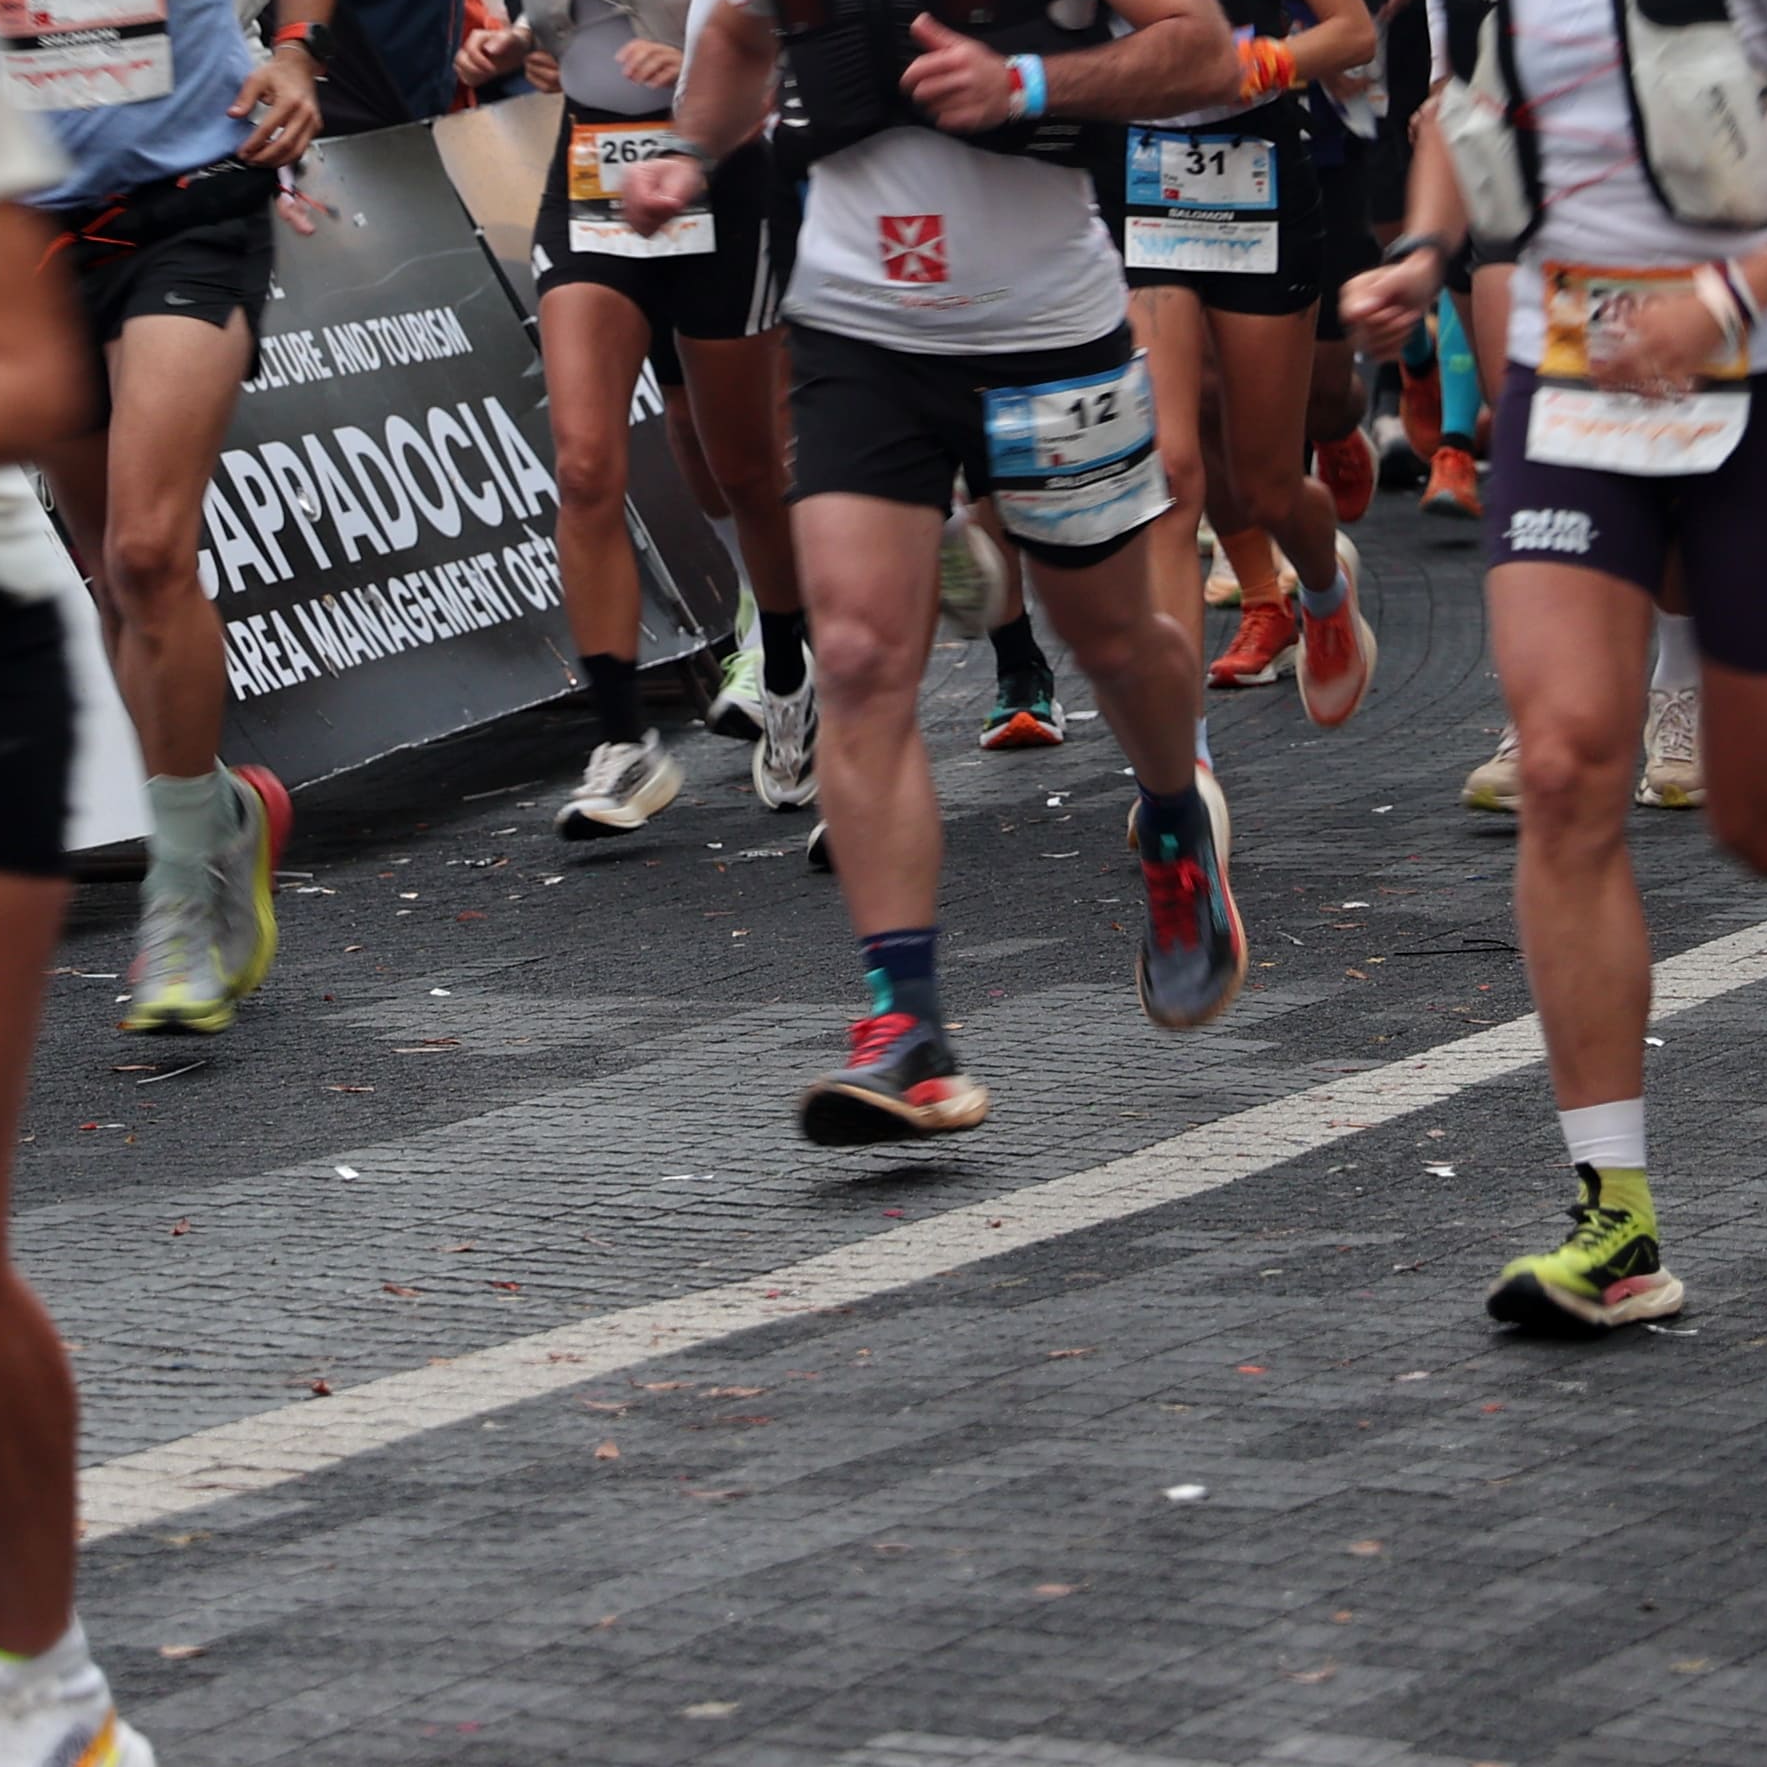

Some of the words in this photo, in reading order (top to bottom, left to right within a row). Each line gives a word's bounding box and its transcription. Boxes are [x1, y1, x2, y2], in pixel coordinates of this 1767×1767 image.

[1185, 150, 1226, 176] 31
[1167, 207, 1236, 222] SALOMON
[239, 330, 334, 394] ULTURE
[322, 318, 382, 377] AND
[365, 306, 474, 367] TOURISM
[1065, 390, 1121, 431] 12
[195, 396, 561, 603] APPADOCIA
[223, 609, 322, 702] AREA
[293, 551, 524, 671] MANAGEMENT
